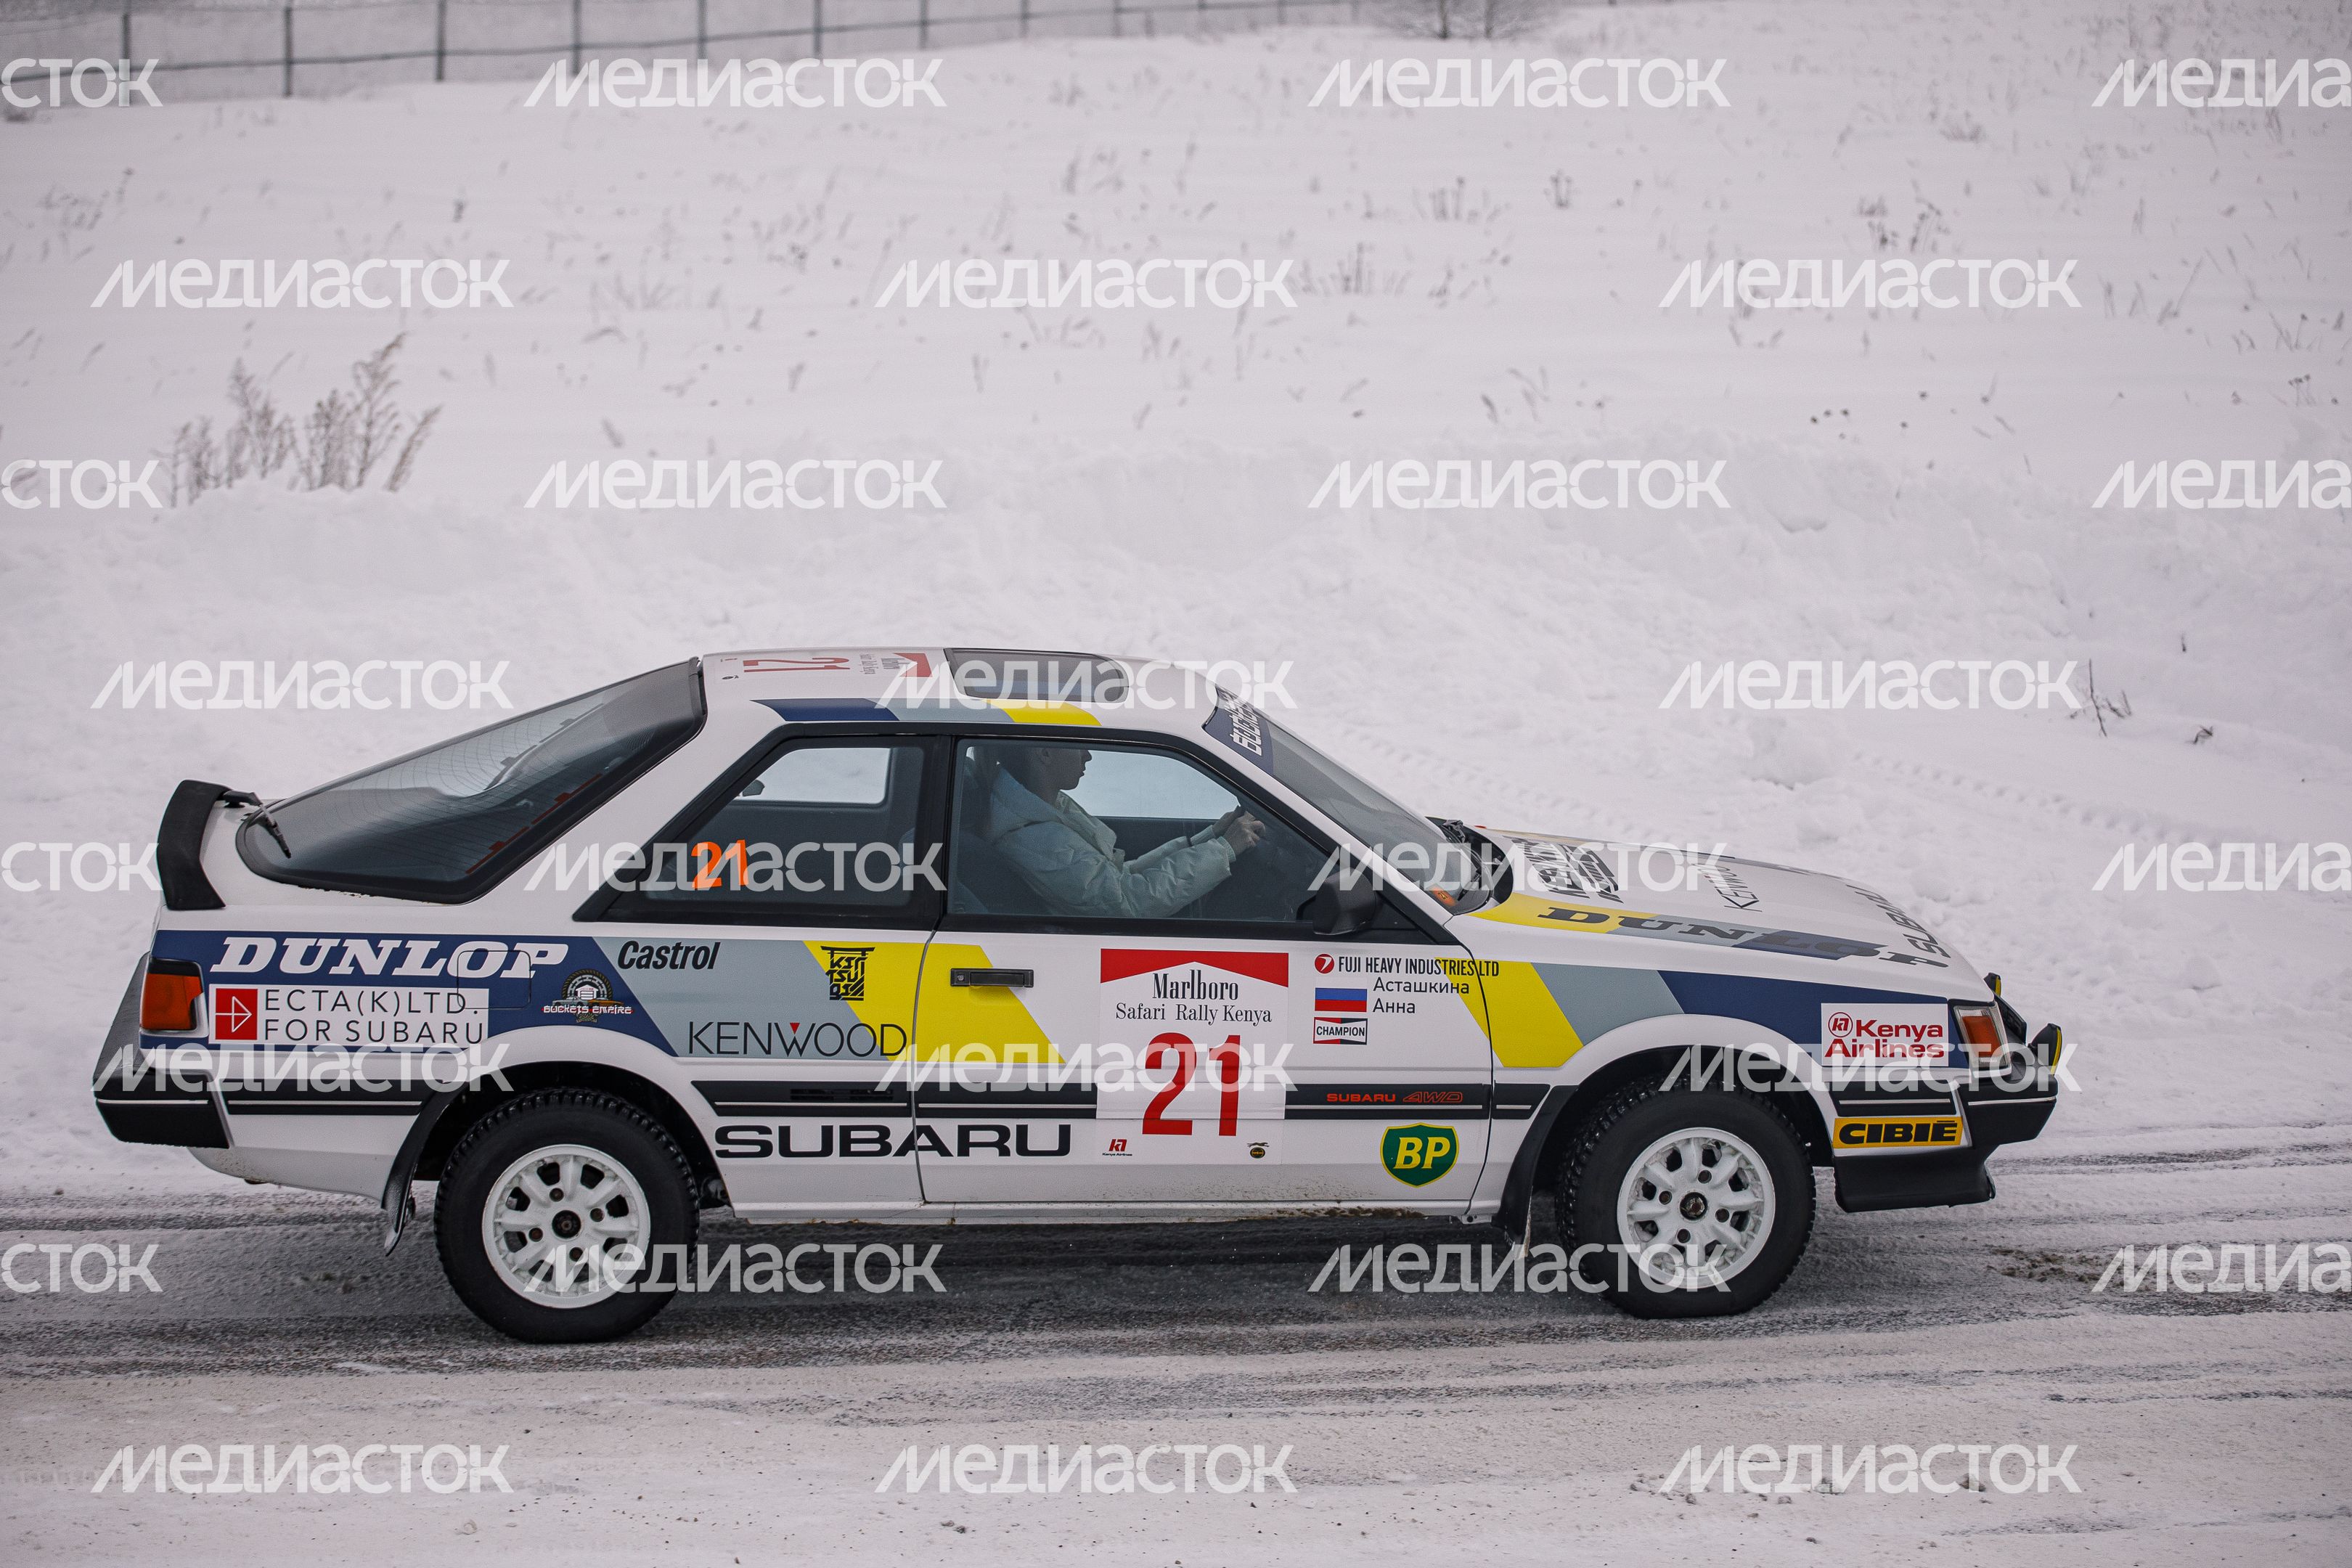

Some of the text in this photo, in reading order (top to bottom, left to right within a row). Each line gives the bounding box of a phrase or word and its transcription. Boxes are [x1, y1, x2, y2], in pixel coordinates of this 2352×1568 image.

[691, 839, 749, 890] 21
[1538, 907, 1950, 968] DUNLOP
[209, 936, 569, 979] DUNLOP
[617, 941, 721, 971] Castrol
[1339, 956, 1500, 977] FUJI HEAVY INDUSTRIES LTD
[1152, 969, 1239, 1000] Marlboro
[1373, 976, 1470, 995] Асташкина
[1116, 1002, 1273, 1026] Safari Rally Kenya
[1372, 997, 1416, 1014] Анна
[264, 1019, 484, 1045] FOR SUBARU
[689, 1021, 907, 1058] KENWOOD
[1316, 1026, 1365, 1037] CHAMPION
[1855, 1019, 1943, 1042] Kenya
[1824, 1038, 1945, 1058] Airlines
[1142, 1032, 1241, 1136] 21
[1327, 1091, 1463, 1103] SUBARU 4WD
[715, 1124, 1071, 1159] SUBARU
[1392, 1136, 1450, 1169] BP
